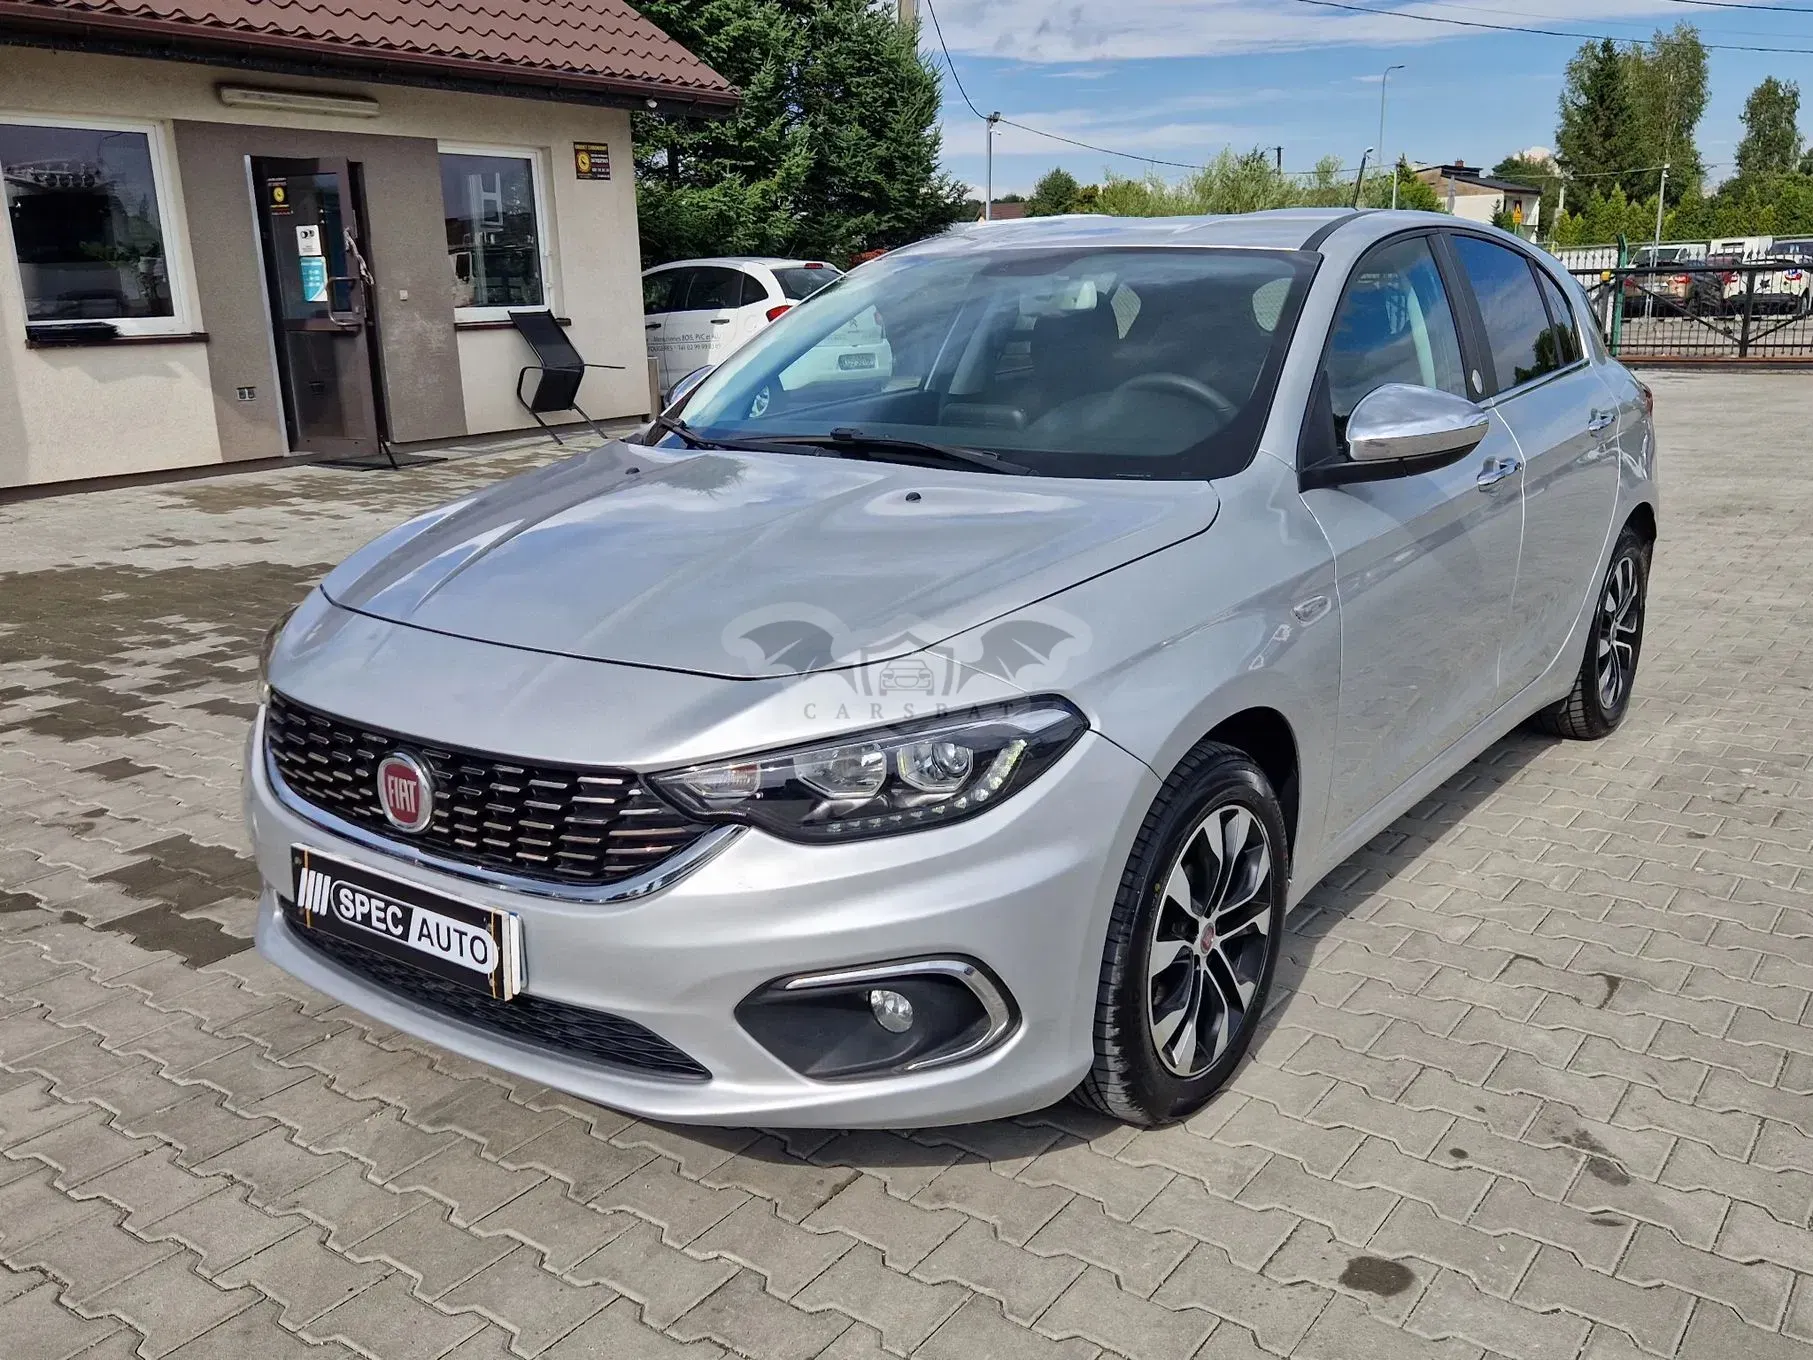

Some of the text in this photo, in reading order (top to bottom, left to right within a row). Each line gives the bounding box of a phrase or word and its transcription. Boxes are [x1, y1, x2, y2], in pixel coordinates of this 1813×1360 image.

[387, 774, 417, 813] FIAT
[339, 888, 488, 965] SPEC AUTO
